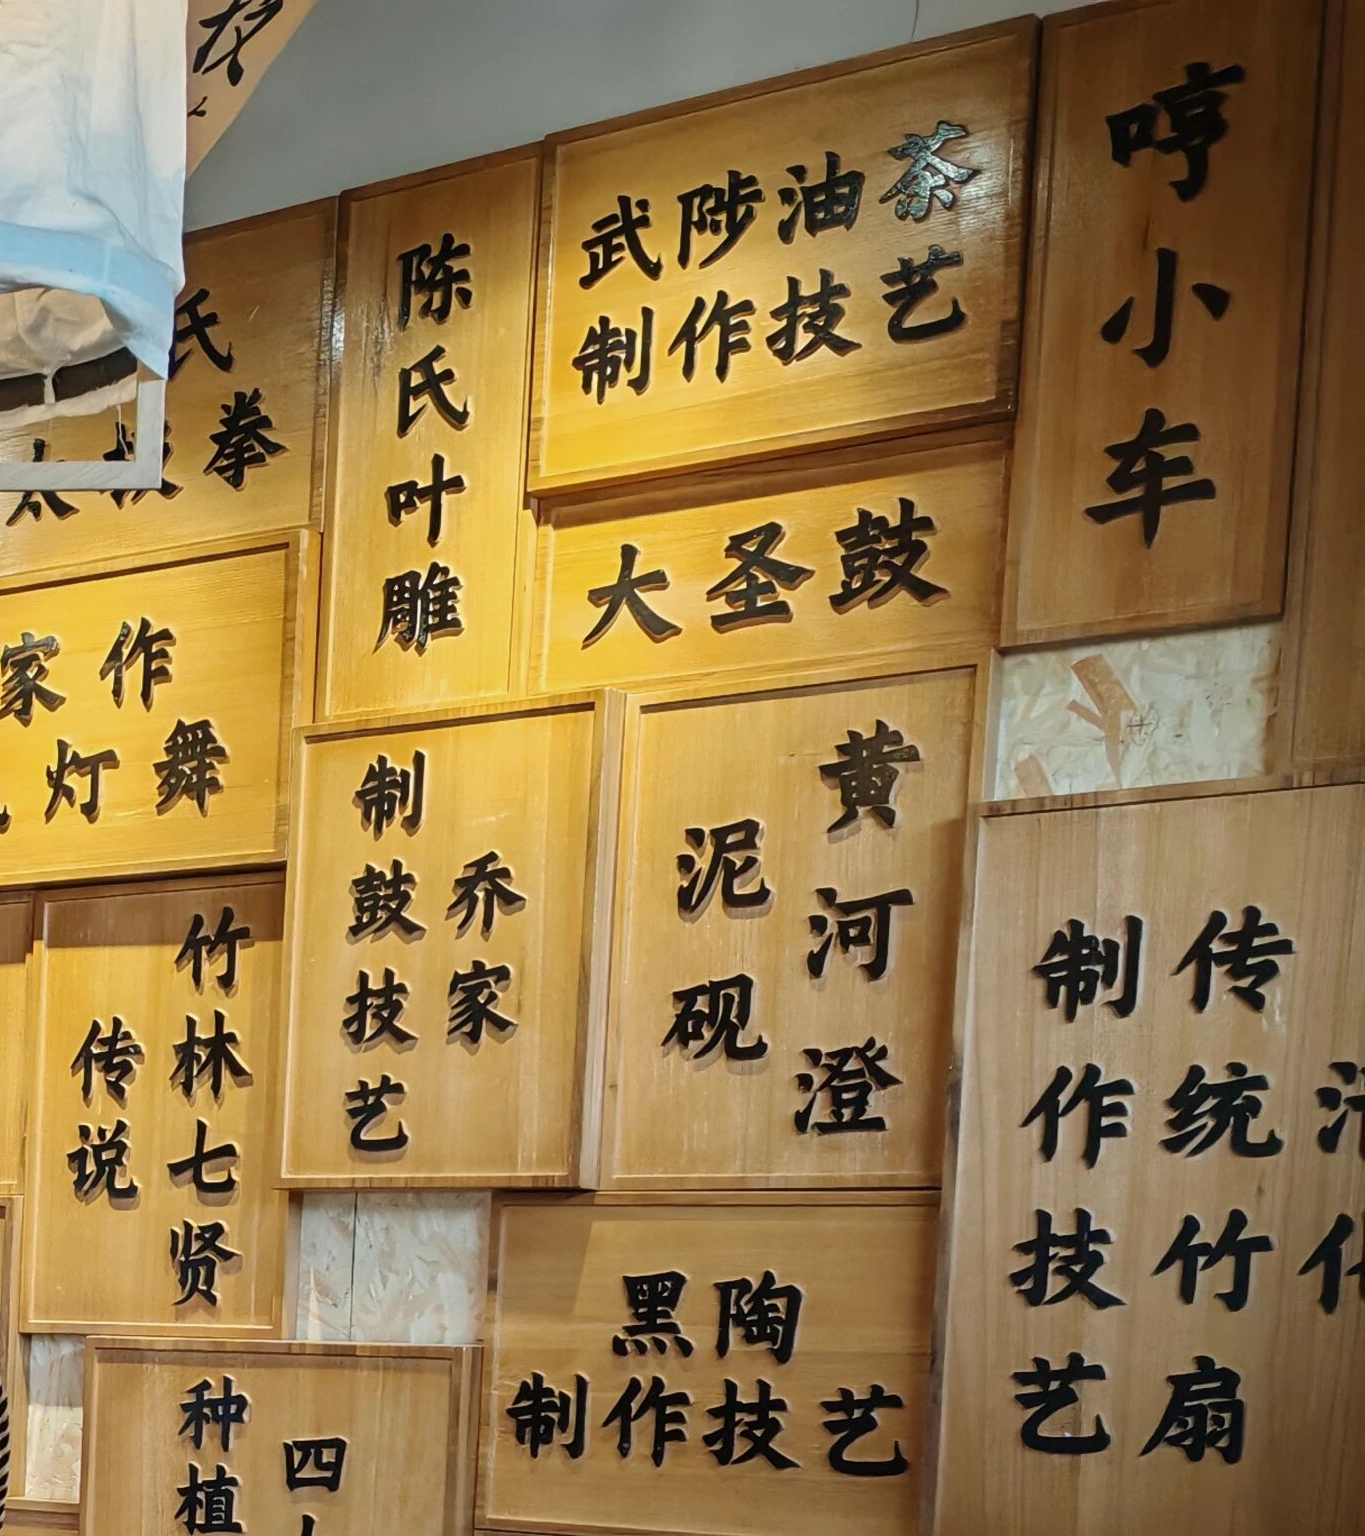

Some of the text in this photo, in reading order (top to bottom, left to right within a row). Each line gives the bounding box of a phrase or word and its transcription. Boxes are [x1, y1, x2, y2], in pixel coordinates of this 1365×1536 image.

[572, 243, 966, 405] 制作技艺
[579, 119, 980, 289] 武陟油茶
[1085, 60, 1246, 549] 哼小车
[372, 233, 473, 655] 陈氏叶雕
[581, 497, 951, 651] 大圣鼓
[342, 750, 426, 1154] 制鼓技艺
[446, 851, 527, 1048] 乔家
[662, 818, 771, 1062] 泥砚
[794, 718, 922, 1137] 黄河澄
[66, 1015, 145, 1202] 传说
[167, 905, 253, 1307] 竹林七贤
[1008, 914, 1144, 1457] 制作技艺
[1139, 905, 1295, 1465] 传统竹扇
[505, 1371, 910, 1479] 制作技艺
[611, 1270, 804, 1365] 黑陶
